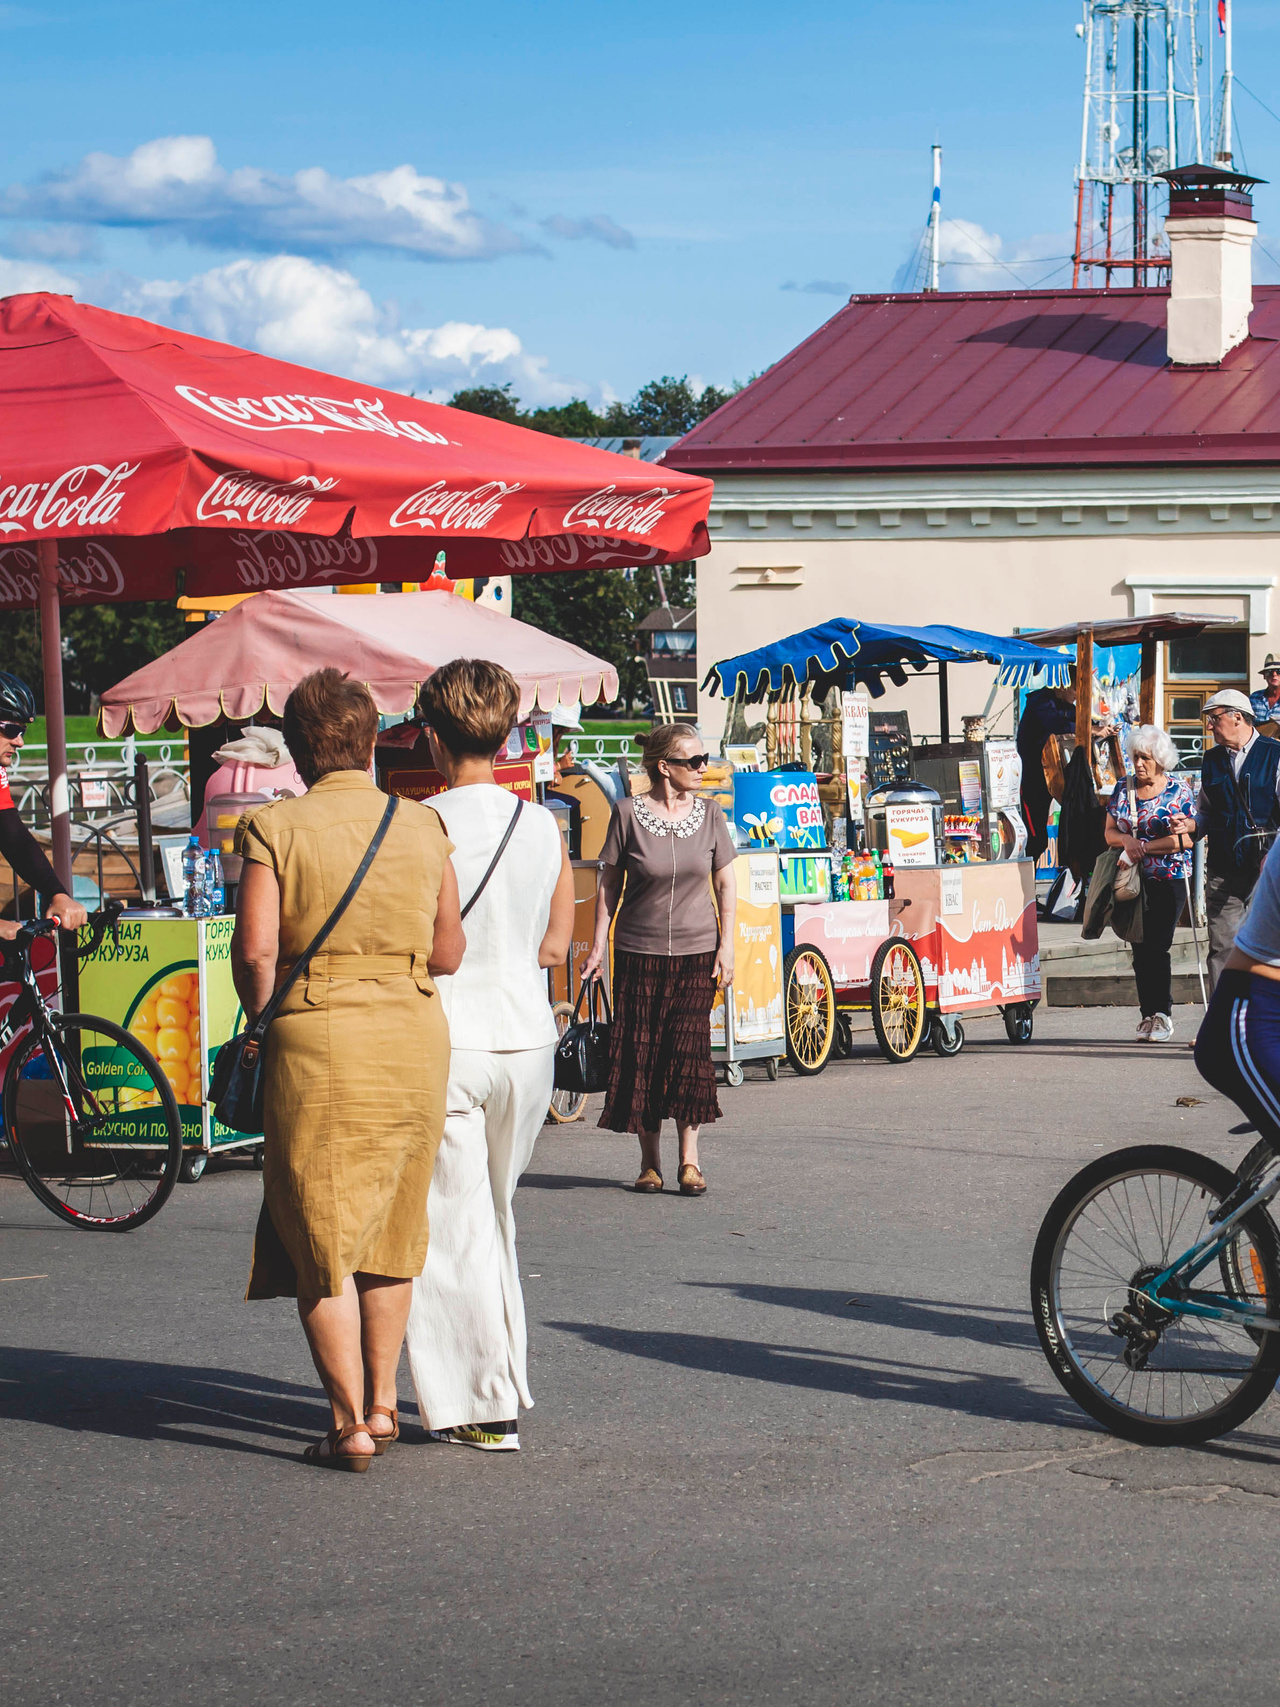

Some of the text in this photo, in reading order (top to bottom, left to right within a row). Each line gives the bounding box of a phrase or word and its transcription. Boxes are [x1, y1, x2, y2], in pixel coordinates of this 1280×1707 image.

[174, 385, 449, 446] Coca-Cola
[0, 461, 141, 534] ca-Cola
[196, 470, 341, 525] Coca-Cola
[389, 480, 527, 530] Coca-Cola
[562, 484, 680, 535] Coca-Cola
[772, 785, 819, 804] СЛАД
[205, 943, 231, 961] КУКУ
[86, 1061, 124, 1076] Golden
[139, 1122, 147, 1137] И
